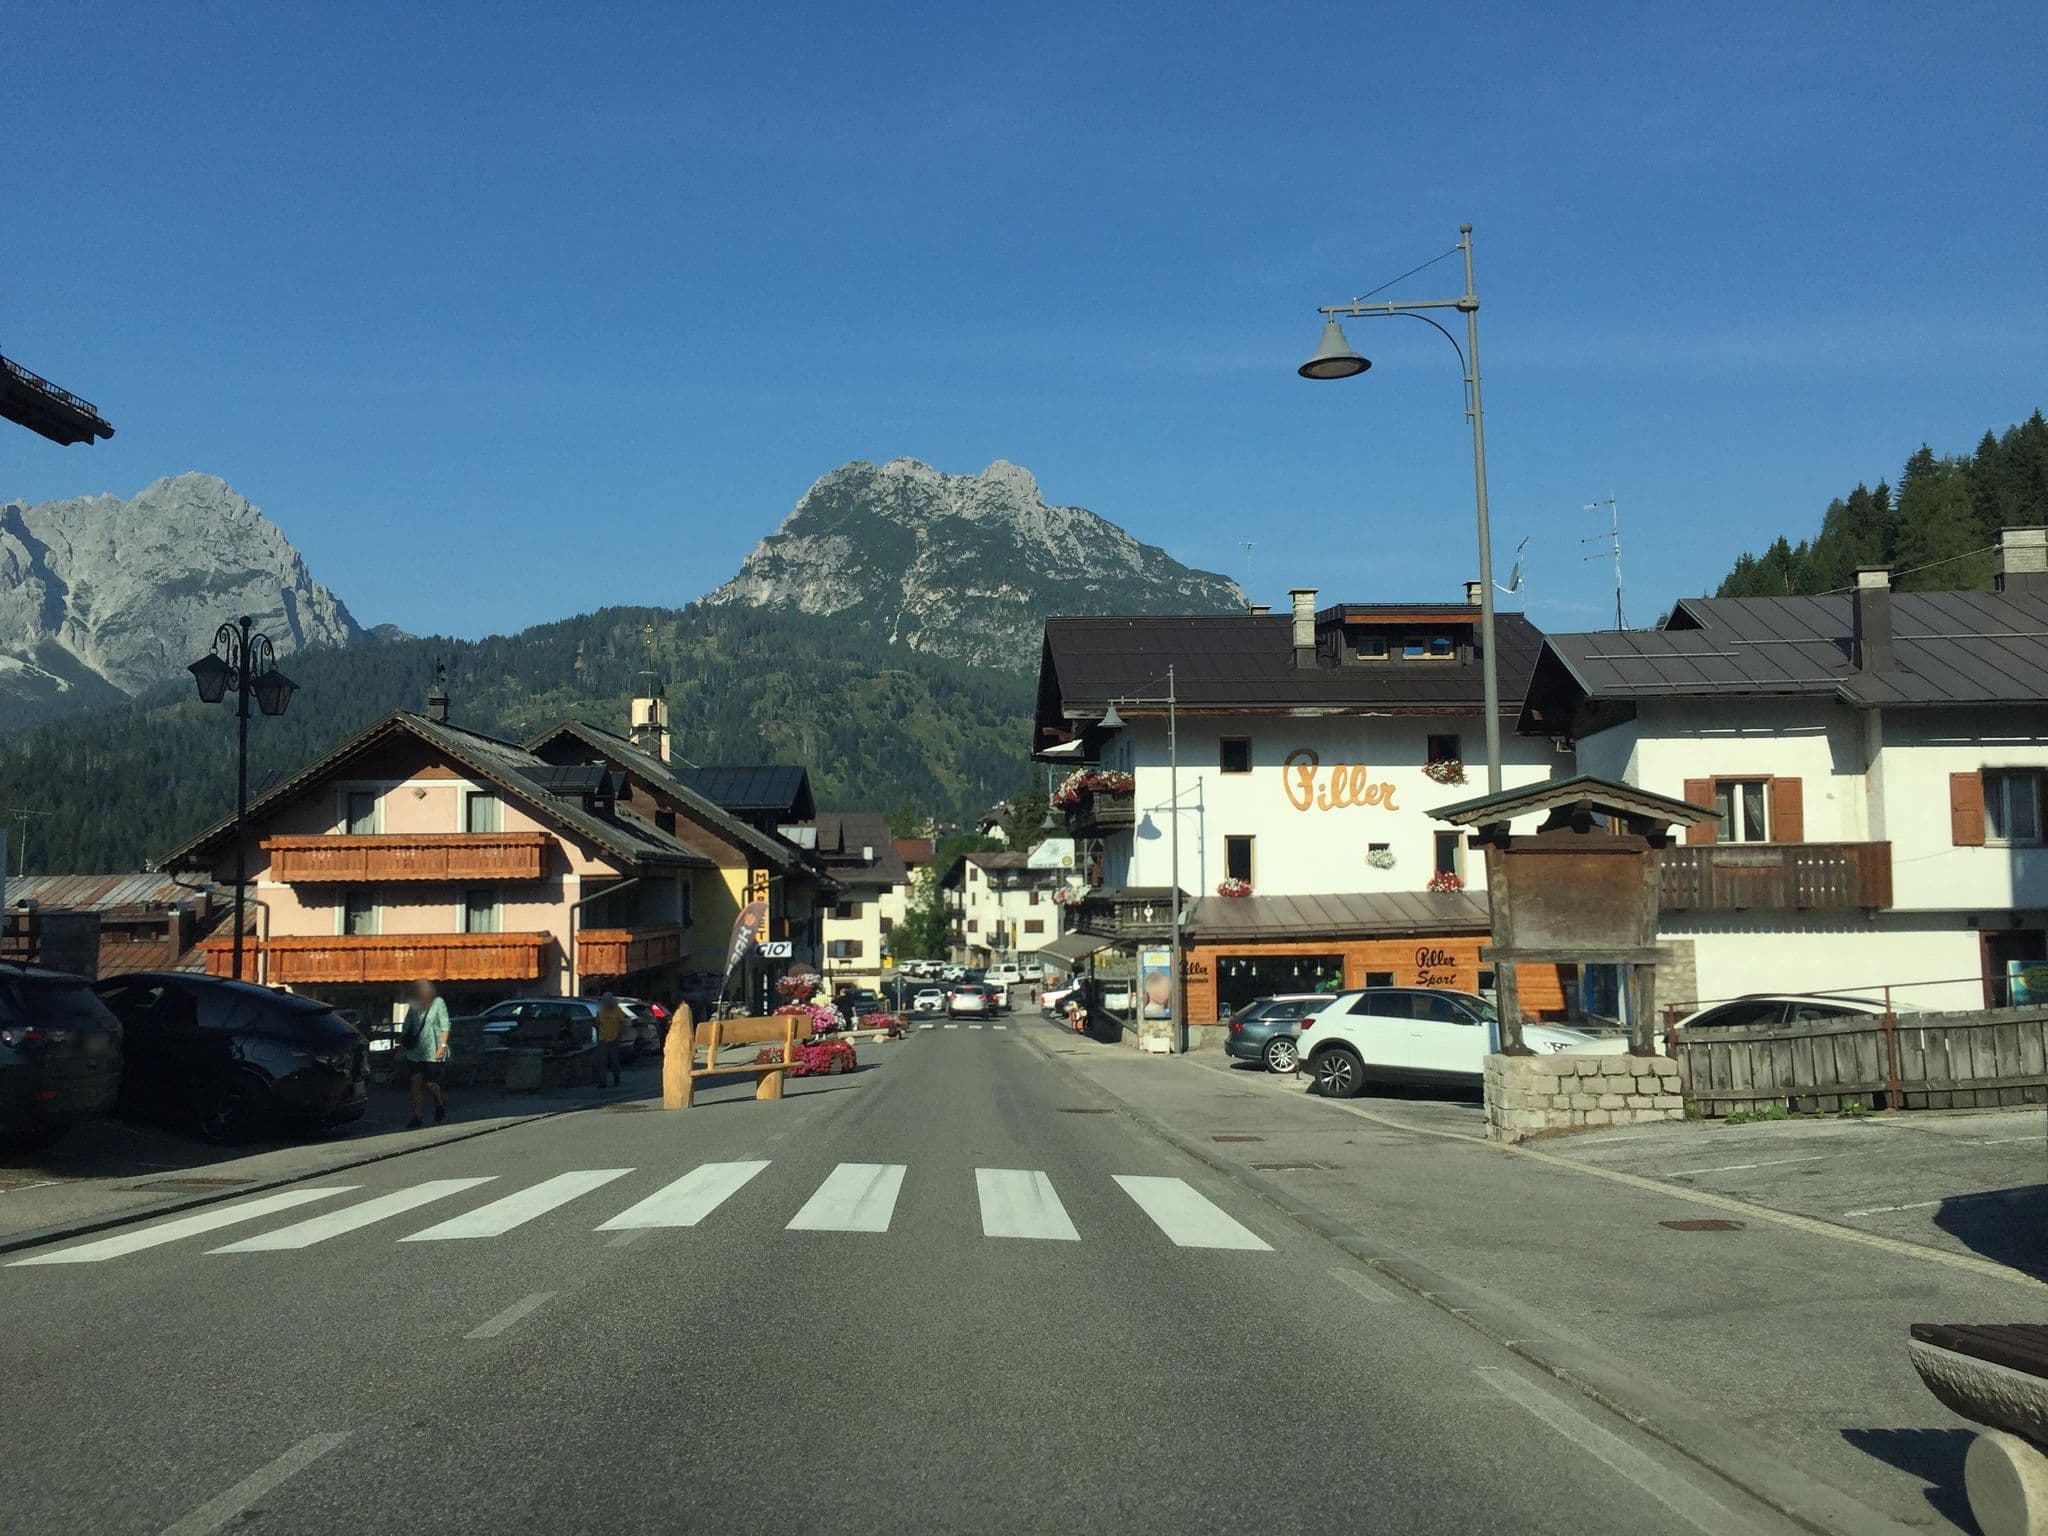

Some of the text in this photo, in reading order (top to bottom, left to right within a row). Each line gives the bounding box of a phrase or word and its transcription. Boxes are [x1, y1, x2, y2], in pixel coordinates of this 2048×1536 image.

[1283, 748, 1399, 811] Piller
[1416, 947, 1456, 967] Piller
[1416, 970, 1456, 987] Sport
